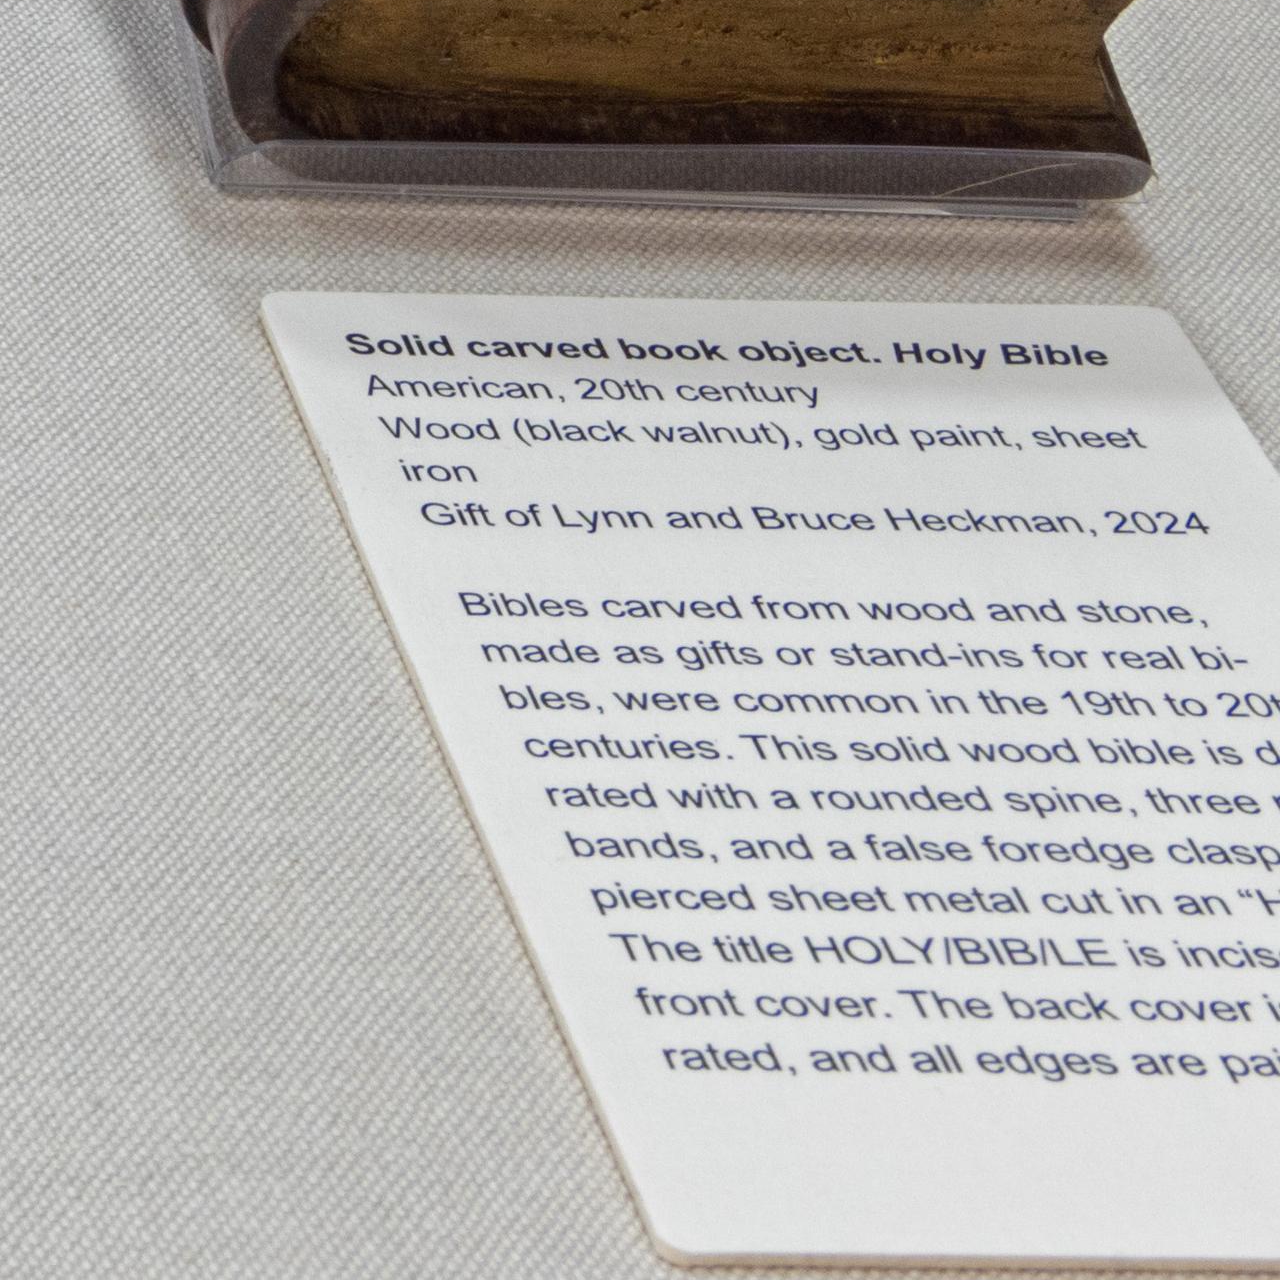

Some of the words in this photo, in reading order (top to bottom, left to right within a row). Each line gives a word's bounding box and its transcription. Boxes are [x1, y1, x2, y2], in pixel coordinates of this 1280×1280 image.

[345, 333, 455, 357] Solid
[466, 337, 610, 360] carved
[616, 337, 729, 361] book
[738, 340, 882, 368] object.
[892, 342, 987, 371] Holy
[999, 343, 1109, 367] Bible
[367, 374, 566, 403] American,
[573, 377, 665, 401] 20th
[675, 381, 818, 409] century
[377, 416, 501, 441] Wood
[512, 417, 635, 447] (black
[641, 420, 803, 451] walnut),
[813, 423, 900, 452] gold
[909, 424, 1023, 452] paint,
[1031, 425, 1148, 449] sheet
[398, 458, 478, 483] iron
[420, 502, 496, 527] Gift
[504, 503, 542, 528] of
[551, 503, 654, 535] Lynn
[665, 505, 744, 530] and
[750, 506, 876, 531] Bruce
[883, 507, 1098, 538] Heckman,
[1103, 510, 1210, 535] 2024
